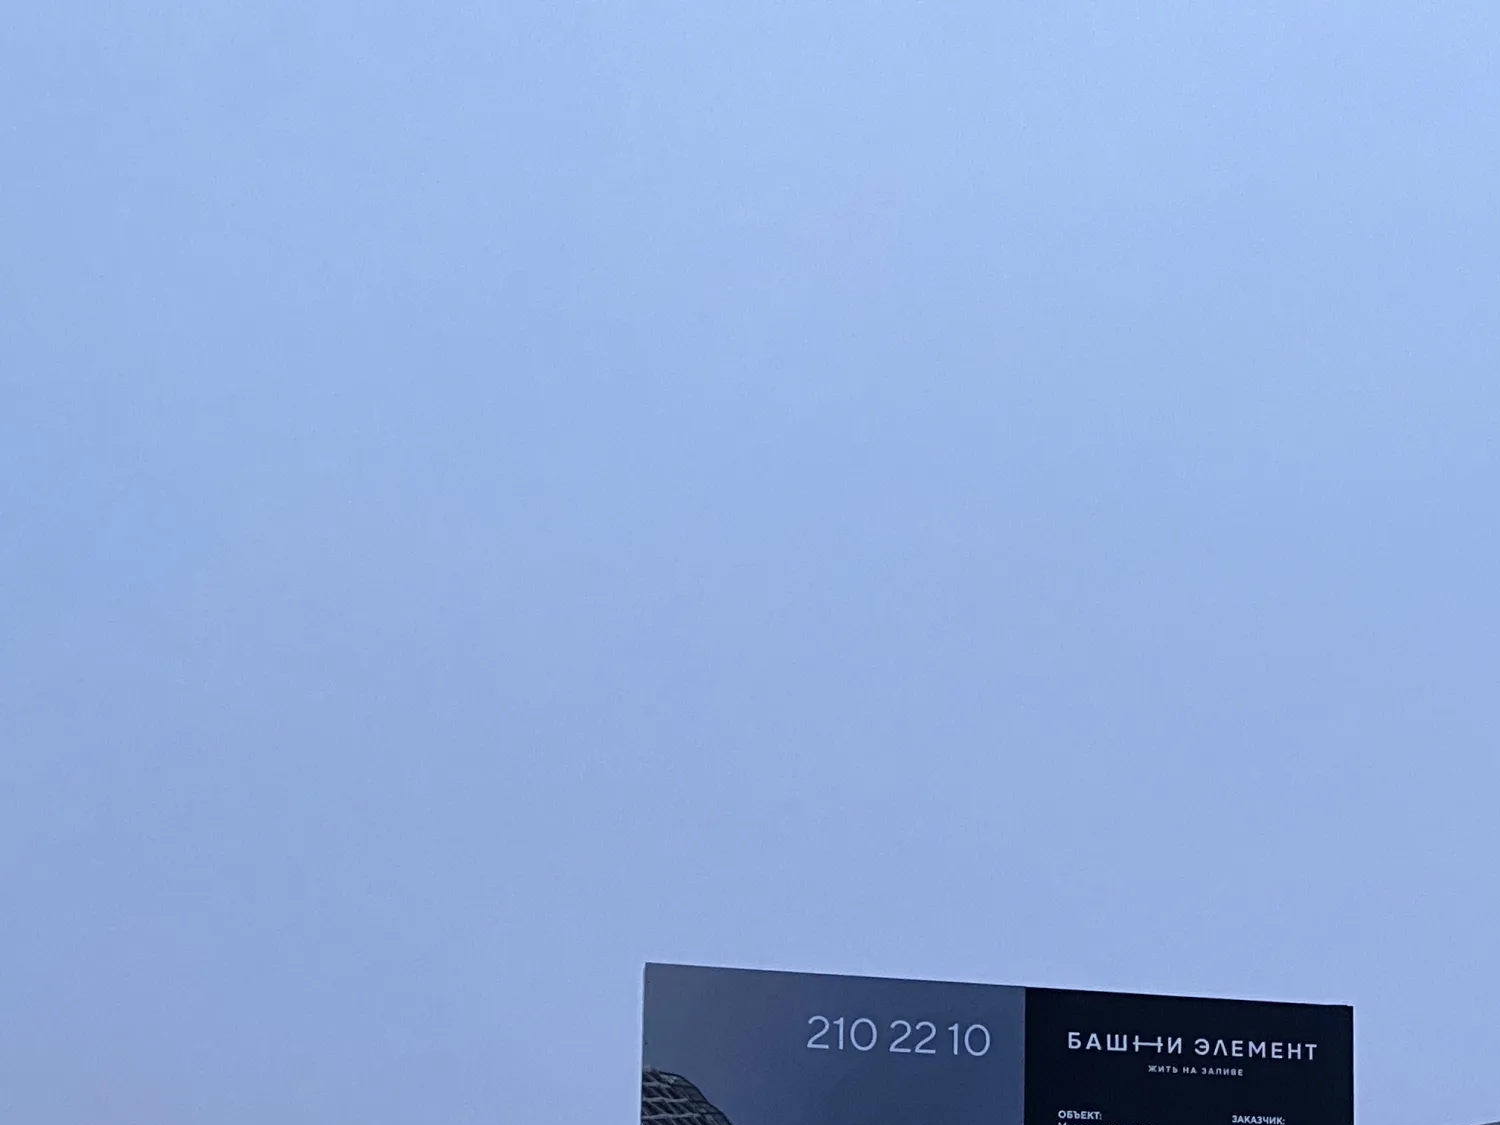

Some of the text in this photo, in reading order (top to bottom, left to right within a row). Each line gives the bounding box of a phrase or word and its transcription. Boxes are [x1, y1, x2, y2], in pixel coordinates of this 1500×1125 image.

[806, 1015, 991, 1058] 210 22 10
[1068, 1032, 1318, 1061] БАШНИ ЭЛЕМЕНТ
[1148, 1065, 1244, 1077] ЖИТЬ НА ЗАЛИВЕ
[1058, 1110, 1102, 1120] ОБЪЕКТ:
[1232, 1115, 1286, 1125] ЗАКАЗЧИК:
